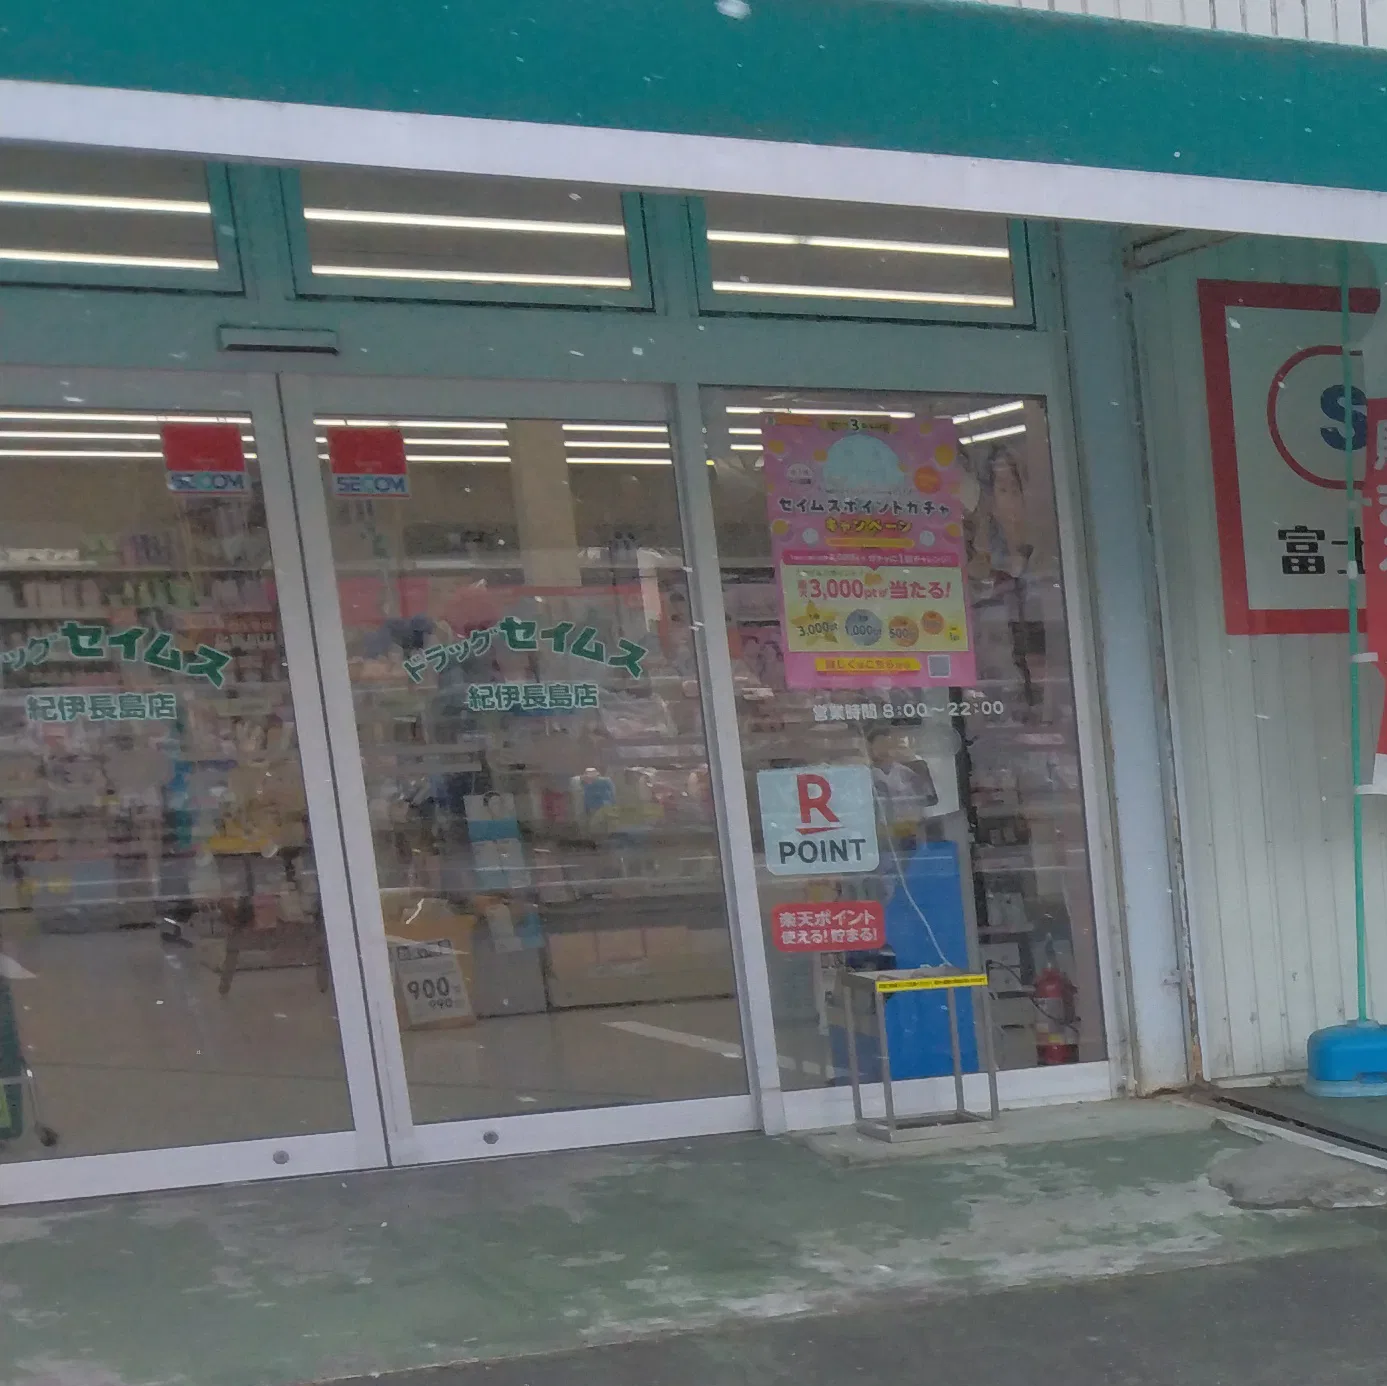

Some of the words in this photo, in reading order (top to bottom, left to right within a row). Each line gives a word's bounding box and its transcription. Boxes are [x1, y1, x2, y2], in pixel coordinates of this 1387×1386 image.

[171, 473, 245, 490] SECOM
[336, 475, 406, 493] SECOM
[467, 682, 599, 711] 紀伊長島店
[26, 692, 178, 722] 紀伊長島店
[812, 704, 878, 721] 営業時間
[778, 838, 866, 864] POINT
[779, 909, 876, 928] 楽天ポイント
